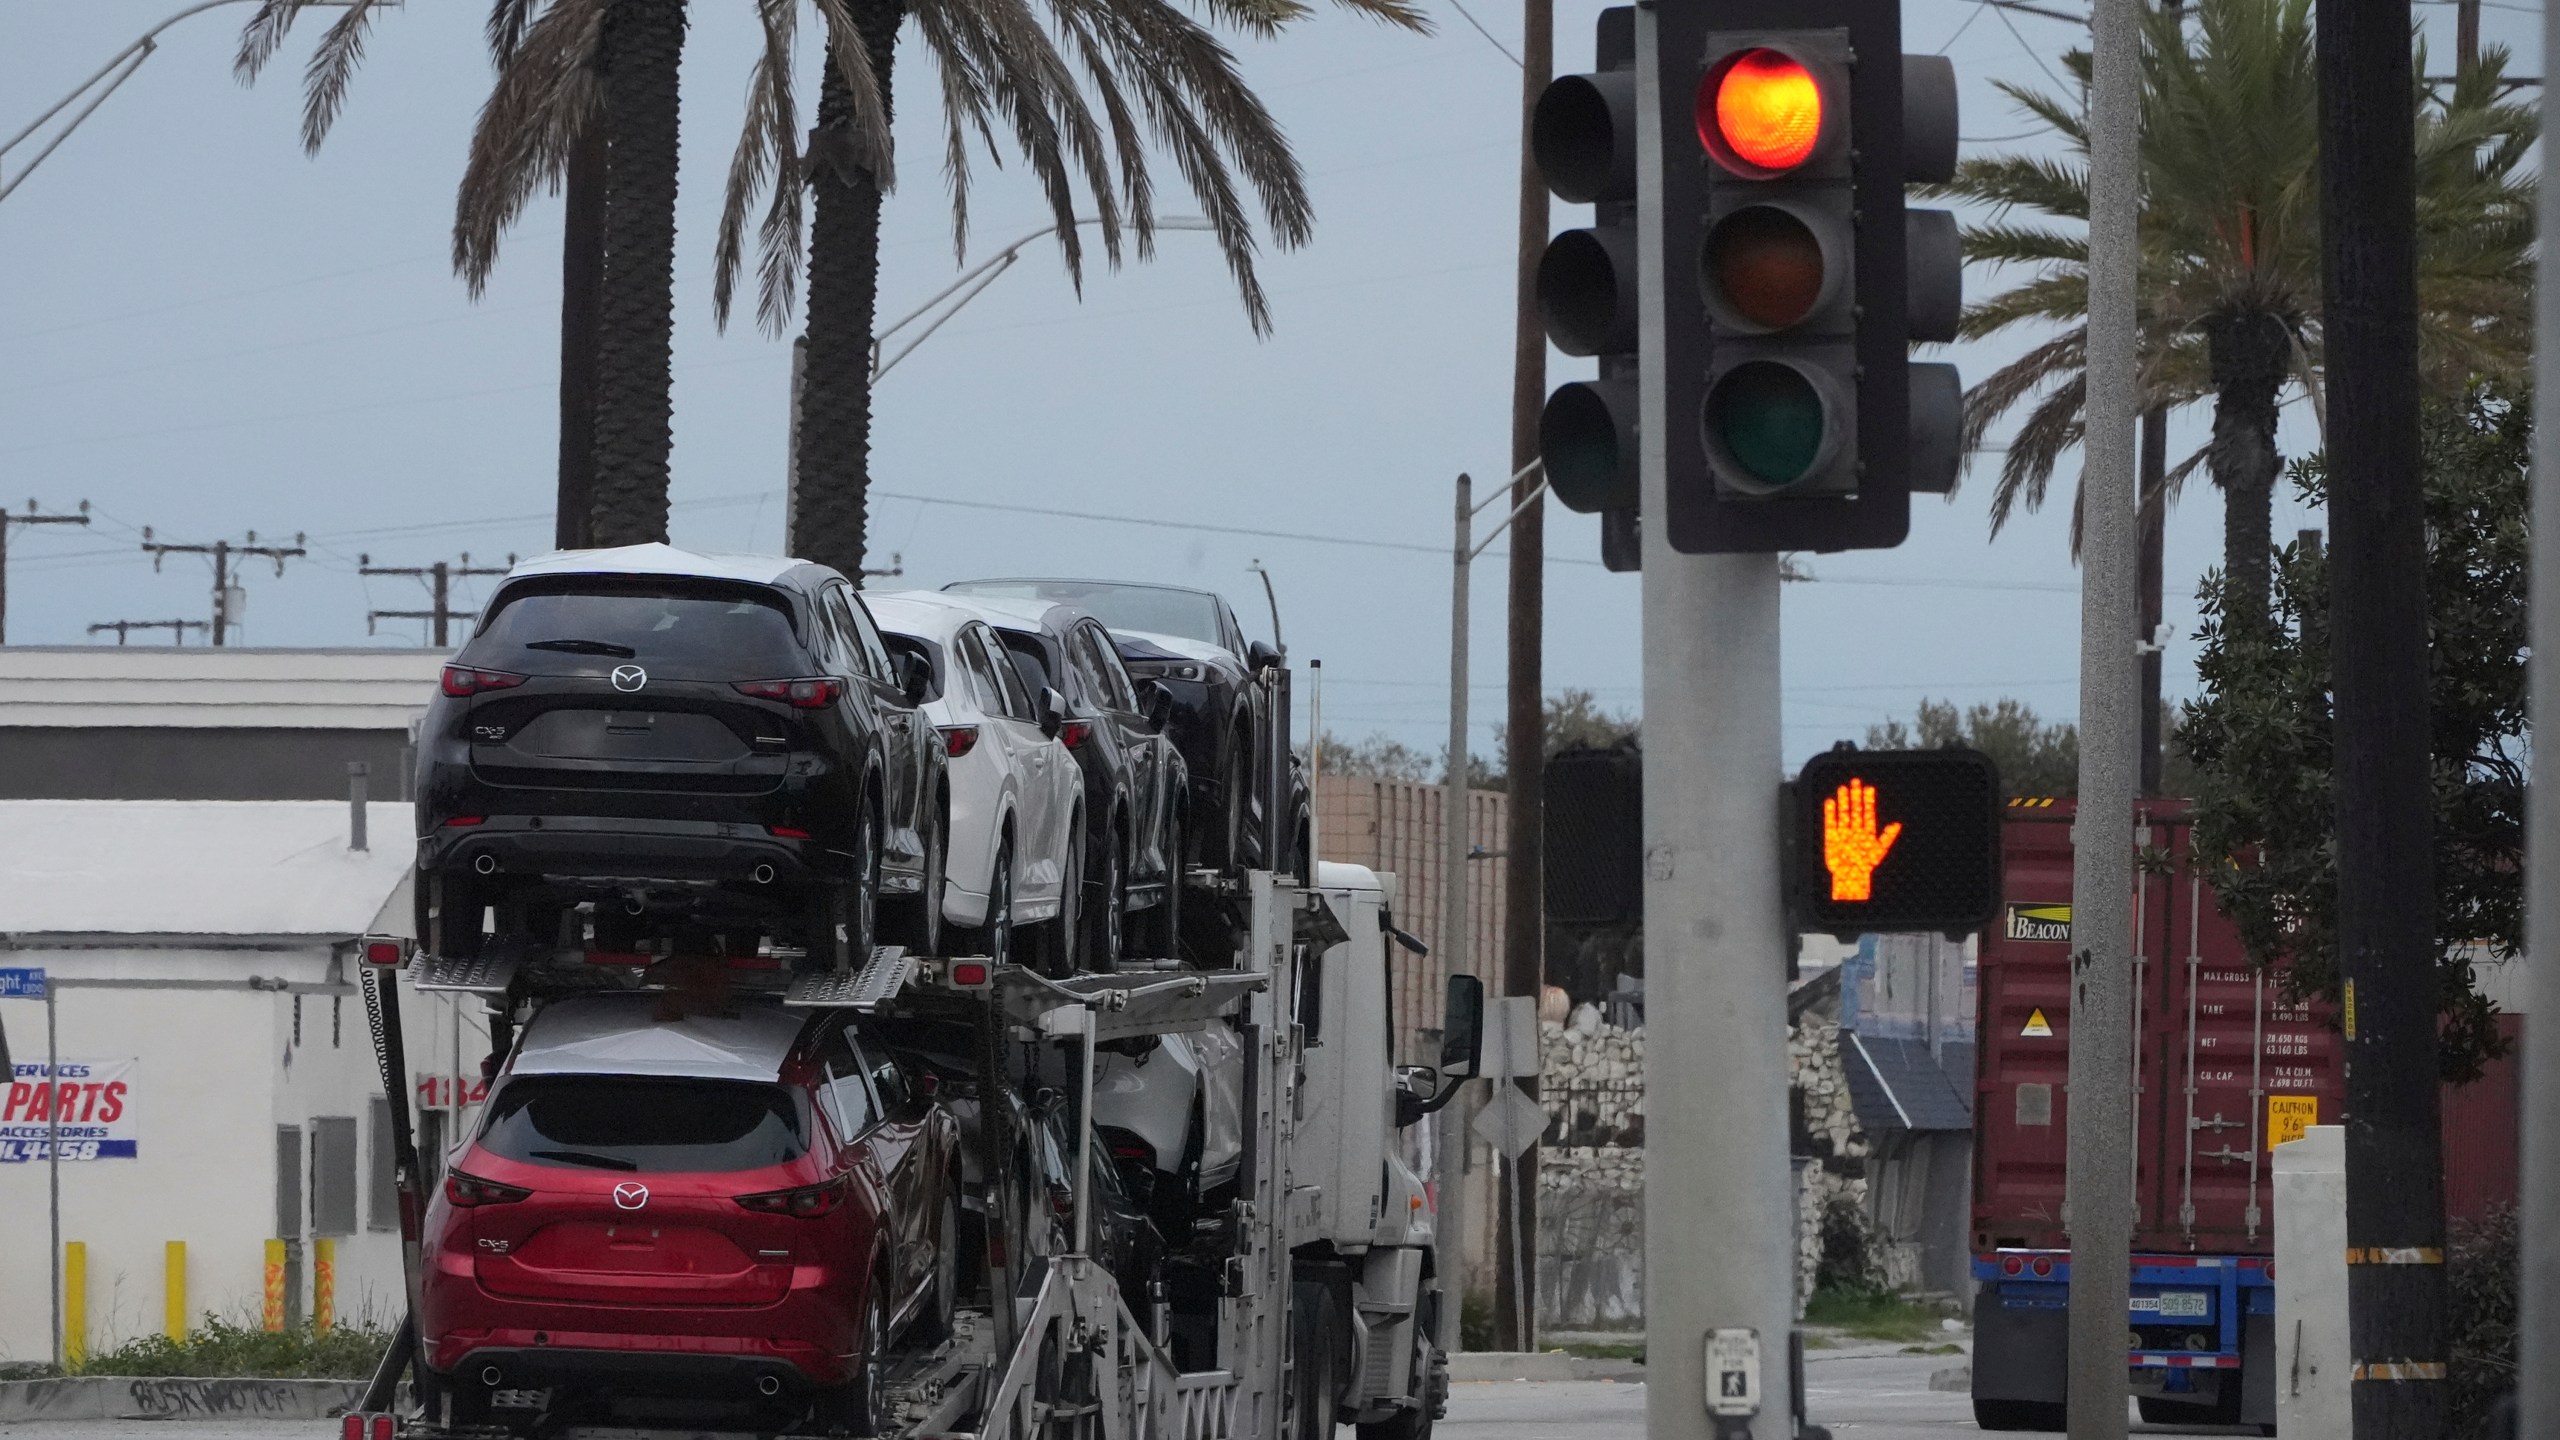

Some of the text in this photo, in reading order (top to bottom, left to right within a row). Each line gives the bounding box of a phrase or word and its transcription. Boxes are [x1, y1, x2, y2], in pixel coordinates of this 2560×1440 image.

[475, 726, 505, 735] CX-5
[2015, 917, 2070, 939] BEACON
[2203, 1005, 2224, 1015] TARE
[2201, 1038, 2217, 1048] NET
[2294, 1035, 2308, 1044] KGS
[2266, 1046, 2308, 1056] 63.160 LBS
[13, 1064, 91, 1077] ERVCES
[2275, 1067, 2291, 1077] 76.4
[2269, 1078, 2291, 1088] 2.698
[2, 1081, 128, 1123] PARTS
[2272, 1101, 2314, 1115] CAUTION
[0, 1126, 109, 1138] ACCESORIES
[478, 1238, 508, 1248] CX-5
[2131, 1300, 2159, 1309] 401354
